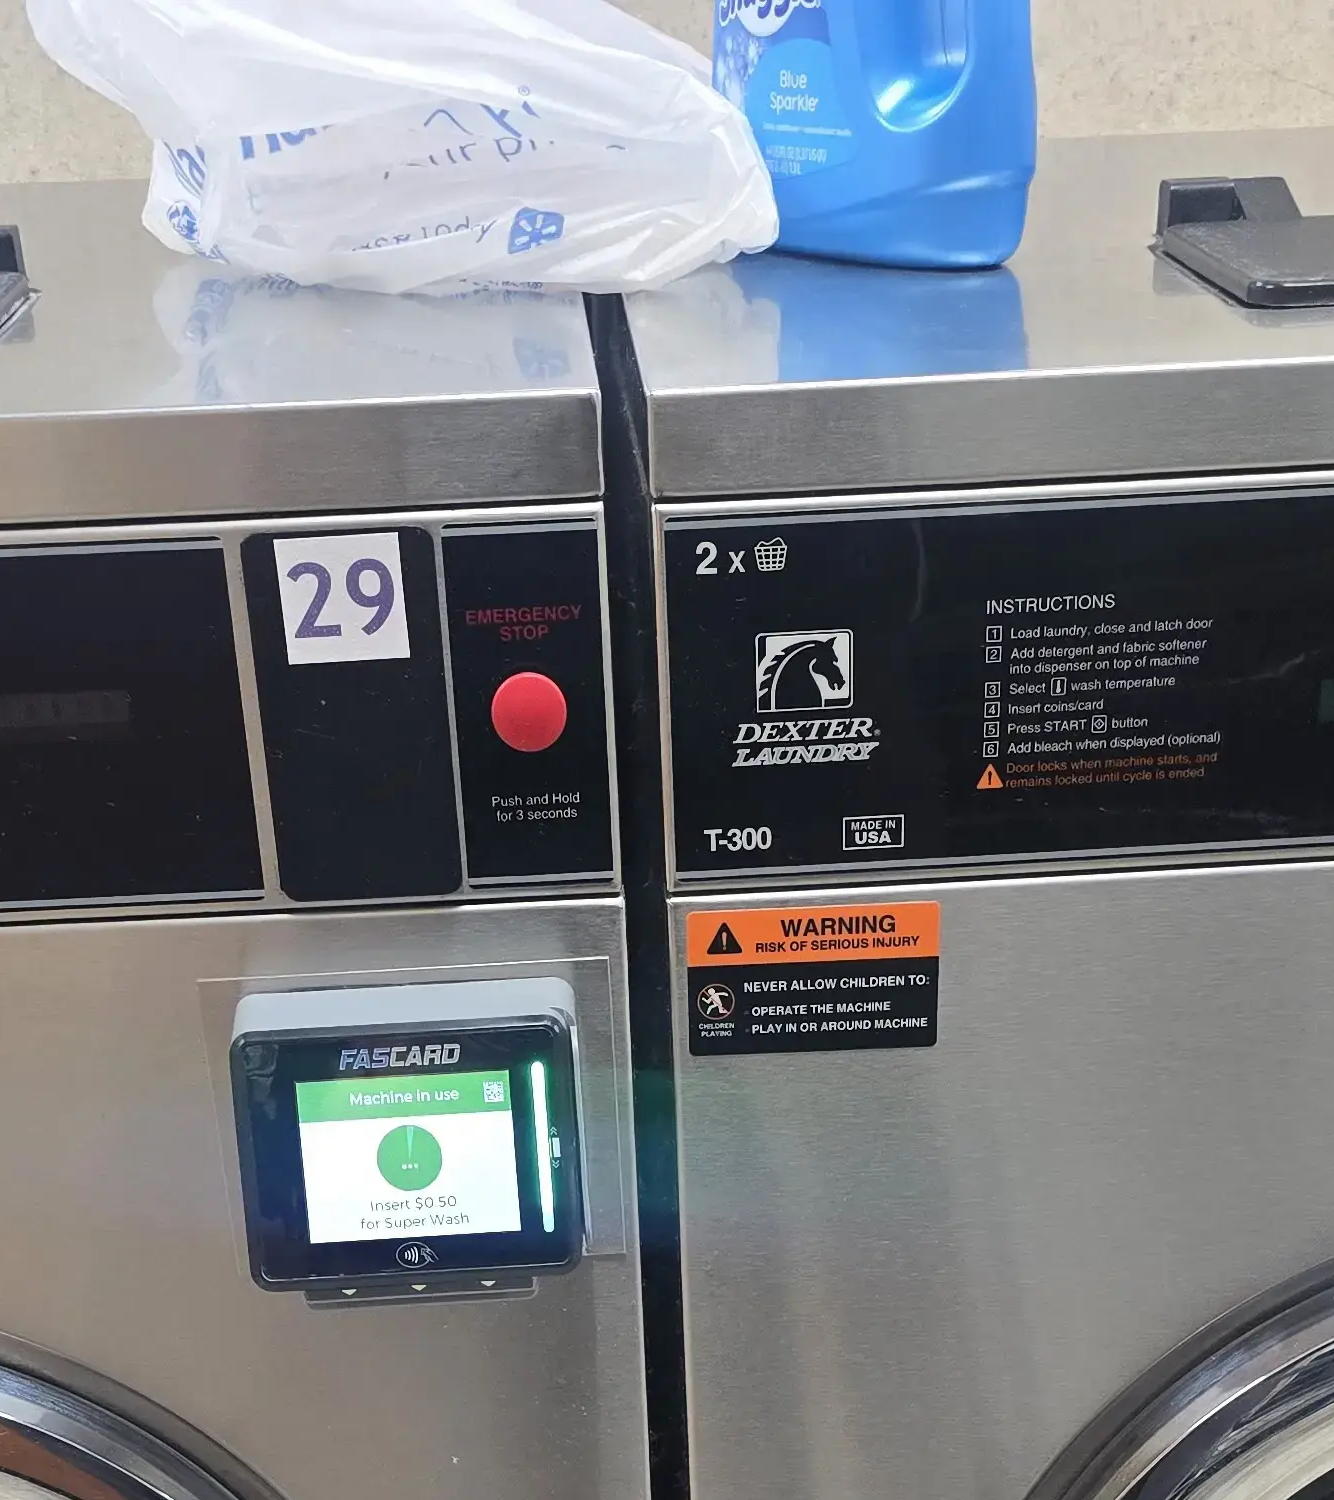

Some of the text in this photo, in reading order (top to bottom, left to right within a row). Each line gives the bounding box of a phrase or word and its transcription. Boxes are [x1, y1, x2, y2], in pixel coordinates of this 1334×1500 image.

[779, 69, 807, 89] Blue
[769, 91, 816, 115] Sparkle
[694, 541, 745, 576] 2 x
[286, 558, 396, 639] 29
[986, 594, 1116, 615] INSTRUCTIONS
[465, 605, 581, 625] EMERGENCY
[499, 625, 549, 642] STOP
[1010, 624, 1040, 641] Load
[1043, 622, 1089, 640] laundry,
[1093, 620, 1125, 637] close
[1128, 619, 1151, 635] and
[1154, 618, 1182, 634] latch
[1185, 616, 1214, 632] door
[1010, 647, 1034, 661] Add
[1037, 644, 1093, 660] detergent
[1096, 642, 1119, 658] and
[1122, 640, 1155, 656] fabric
[1158, 637, 1207, 655] softener
[1008, 653, 1200, 676] into dispenser on top of machine
[1008, 682, 1046, 696] Select
[1070, 678, 1101, 693] wash
[1104, 675, 1177, 692] temperature
[1007, 701, 1040, 715] Insert
[1043, 698, 1104, 714] coins/card
[732, 717, 874, 745] DEXTER
[1006, 720, 1040, 735] Press
[1043, 718, 1087, 734] START
[1111, 716, 1149, 729] button
[1006, 740, 1031, 755] Add
[1033, 738, 1072, 754] bleach
[1075, 737, 1107, 752] when
[1109, 734, 1164, 751] displayed
[1167, 731, 1221, 748] (optional)
[731, 741, 879, 767] LAUNDRY
[491, 791, 580, 809] Push and Hold
[495, 806, 578, 823] for 3 seconds
[851, 819, 897, 832] MADE IN
[703, 826, 772, 853] T-300
[854, 829, 892, 845] USA
[780, 914, 897, 938] WARNING
[754, 935, 920, 954] RISK OF SERIOUS INJURY
[743, 974, 931, 994] NEVER ALLOW CHILDREN TO:
[751, 1000, 891, 1018] OPERATE THE MACHINE
[751, 1016, 929, 1035] PLAY IN OR AROUND MACHINE
[339, 1044, 460, 1071] FASCARD
[349, 1089, 459, 1107] Machine in use
[370, 1195, 457, 1212] Insert $0.50
[360, 1212, 470, 1230] for Super Wash
